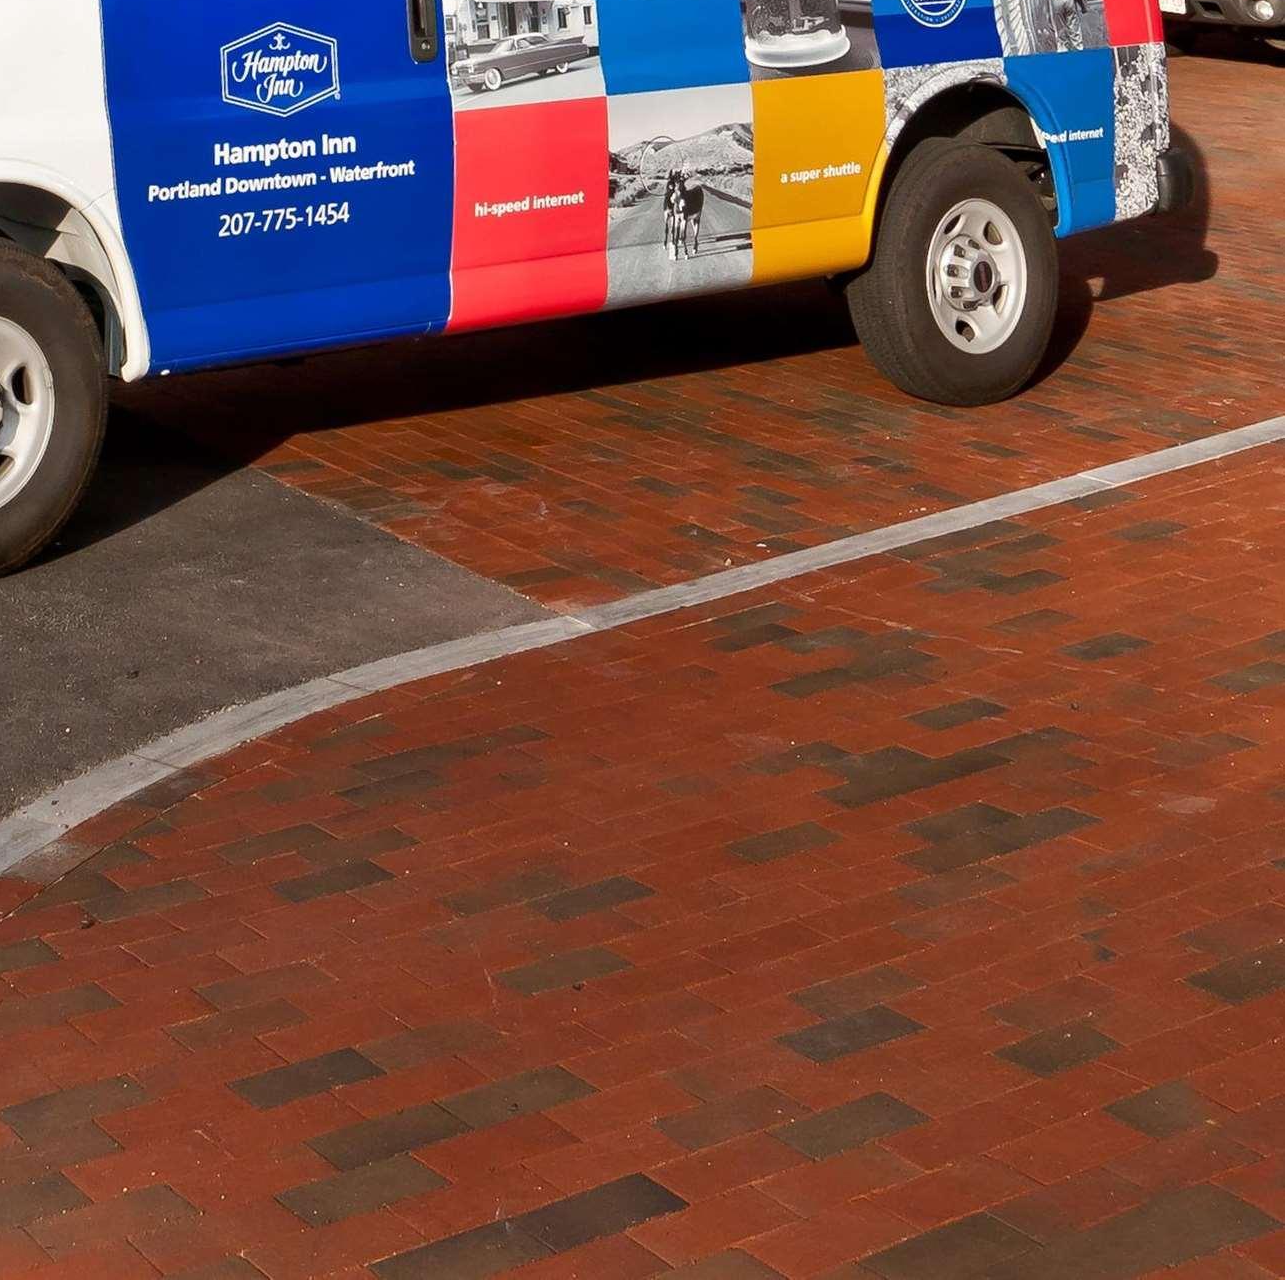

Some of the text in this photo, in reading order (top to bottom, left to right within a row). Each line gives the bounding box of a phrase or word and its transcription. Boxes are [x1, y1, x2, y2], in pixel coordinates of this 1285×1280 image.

[232, 49, 328, 83] Hampton
[256, 72, 304, 103] Inn
[213, 133, 357, 167] Hampton Inn
[1068, 126, 1104, 142] internet
[147, 177, 221, 202] Portland
[224, 169, 317, 195] Downtown
[329, 159, 416, 184] Waterfront
[780, 161, 862, 184] a super shuttle
[217, 200, 351, 238] 207-775-1454
[474, 190, 585, 218] hi-speed internet
